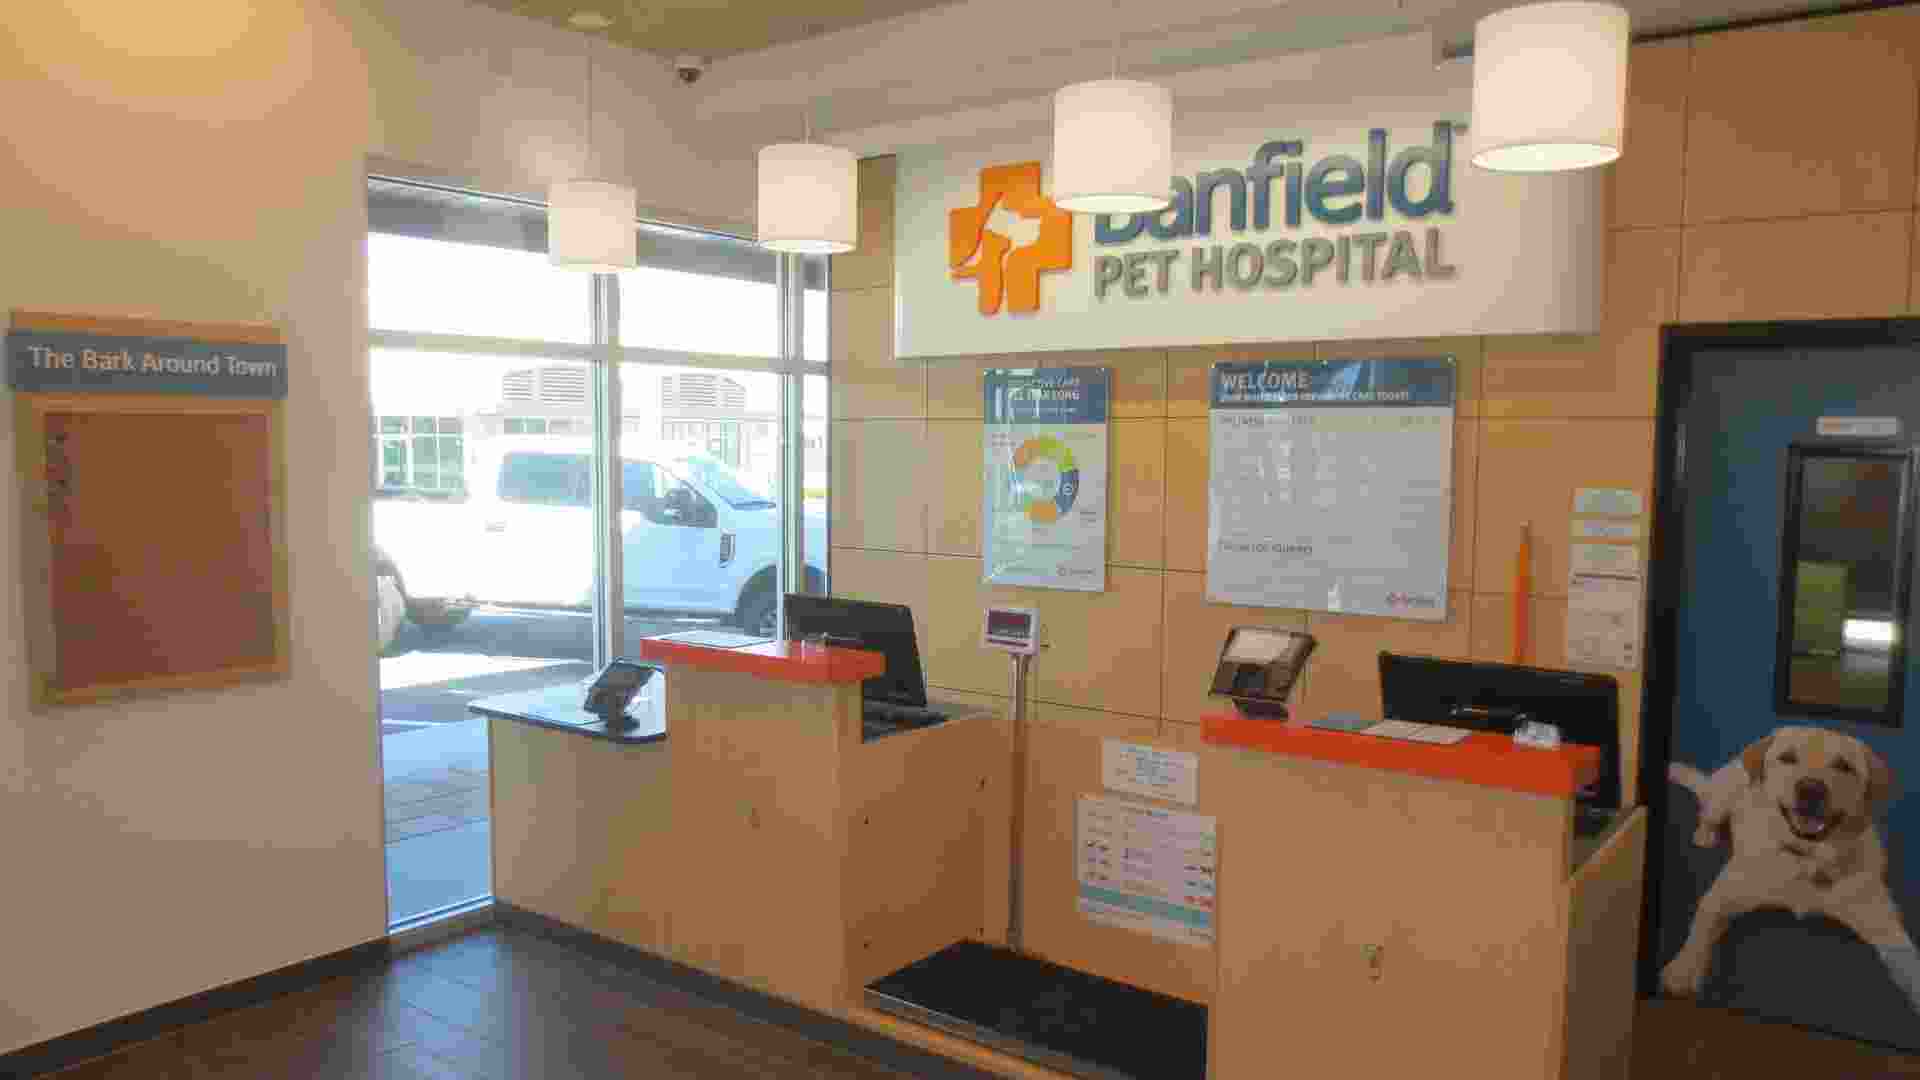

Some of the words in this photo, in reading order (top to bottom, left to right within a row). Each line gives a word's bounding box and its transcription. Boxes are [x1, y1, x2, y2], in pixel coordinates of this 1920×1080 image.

[1094, 250, 1179, 301] PET
[1191, 228, 1456, 293] HOSPITAL
[27, 344, 75, 369] The
[82, 347, 136, 372] Bark
[141, 352, 220, 376] Around
[224, 354, 279, 377] Town
[1220, 371, 1310, 390] WELCOME
